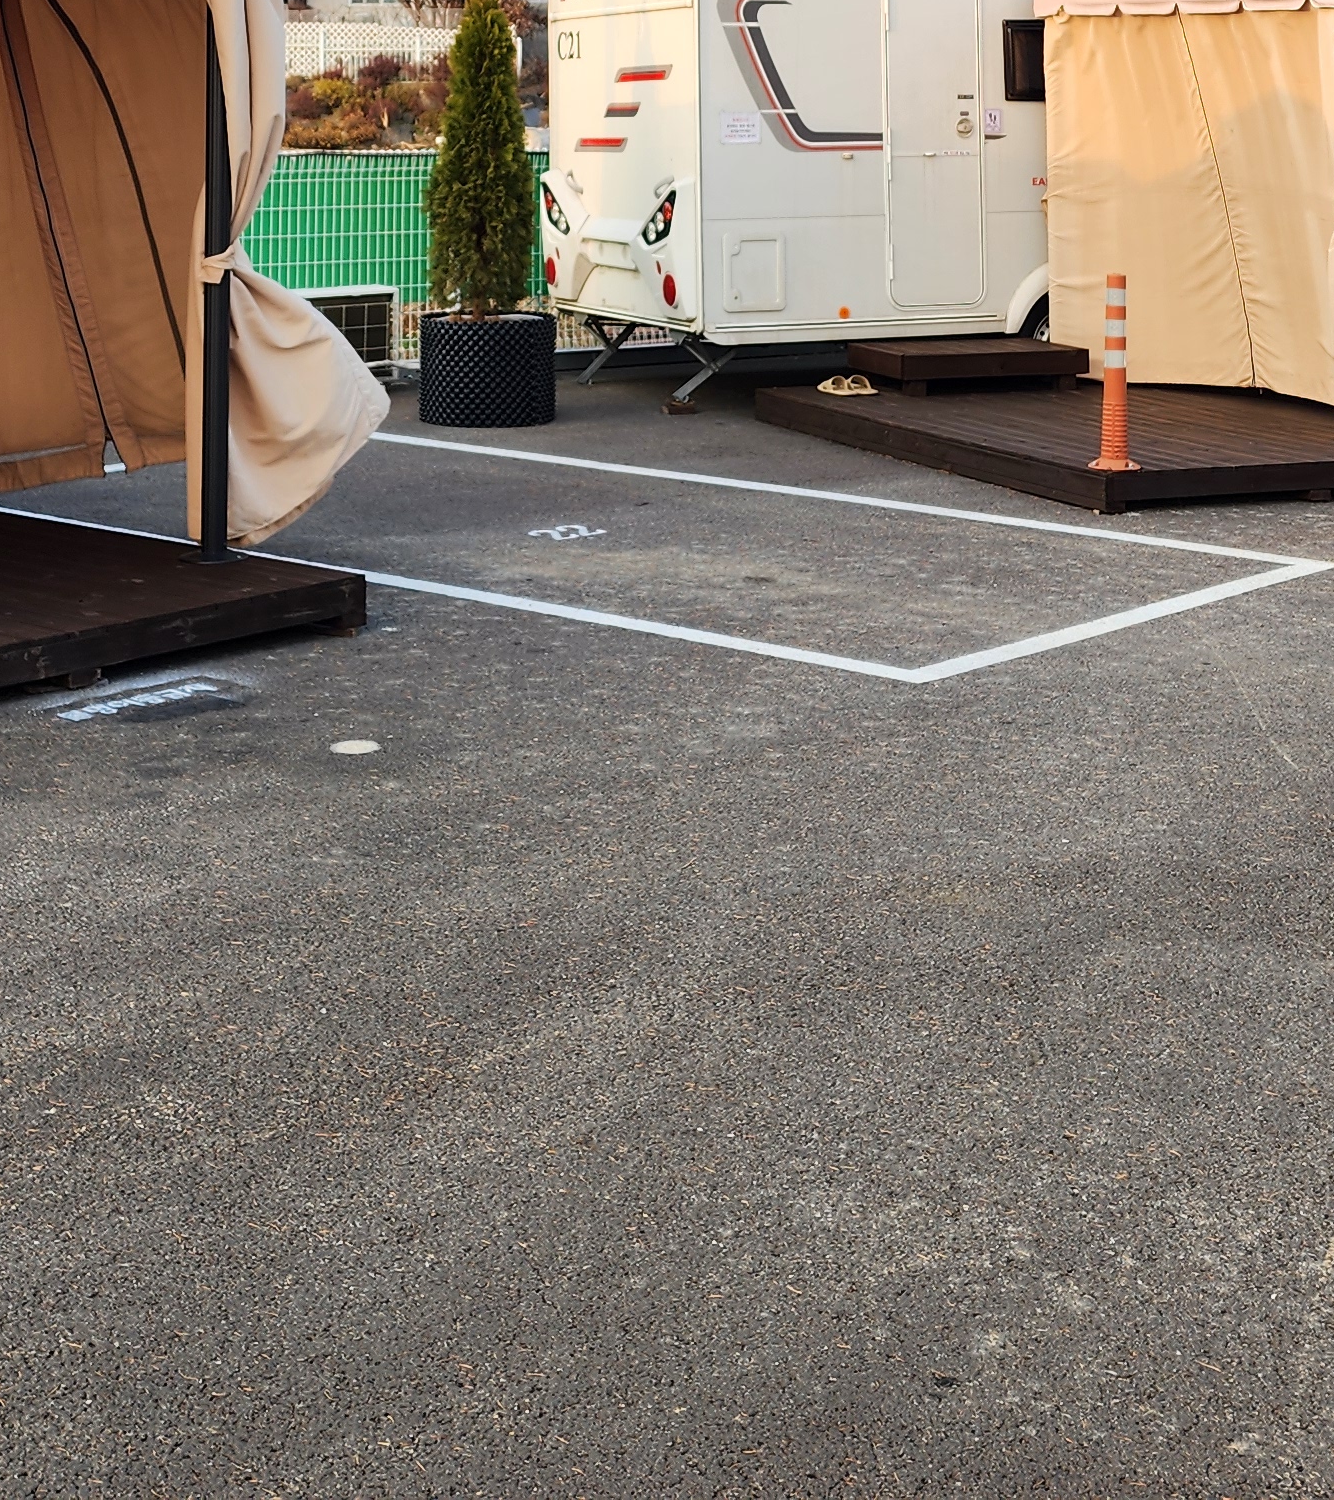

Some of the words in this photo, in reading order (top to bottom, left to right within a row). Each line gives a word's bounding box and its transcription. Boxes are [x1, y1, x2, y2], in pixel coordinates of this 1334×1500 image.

[557, 30, 581, 61] C21
[1032, 177, 1047, 186] EA
[527, 524, 608, 541] 22
